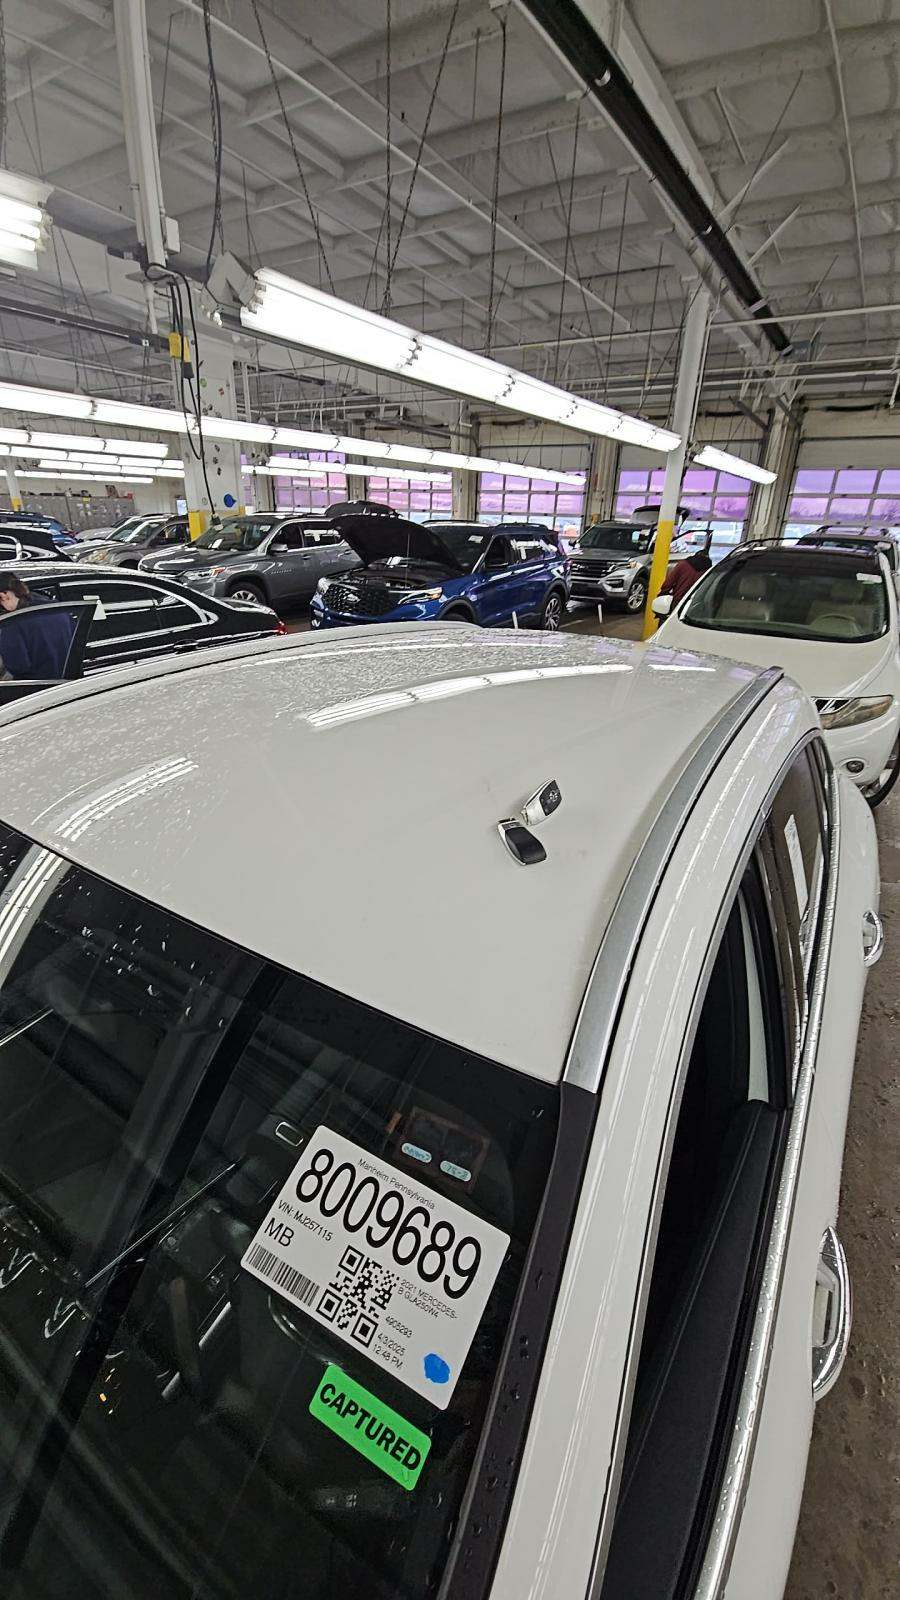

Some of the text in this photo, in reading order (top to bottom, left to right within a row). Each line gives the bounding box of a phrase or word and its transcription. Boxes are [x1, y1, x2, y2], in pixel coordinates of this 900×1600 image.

[359, 1159, 435, 1209] Manheim Pennsylvania
[264, 1217, 295, 1247] MB
[278, 1200, 333, 1241] VIN: MJ257115
[296, 1148, 481, 1299] 8009689
[397, 1286, 404, 1296] B
[400, 1278, 416, 1292] 2021
[377, 1332, 405, 1357] 4/3/2025
[390, 1354, 404, 1369] PM
[320, 1384, 421, 1470] CAPTURED
